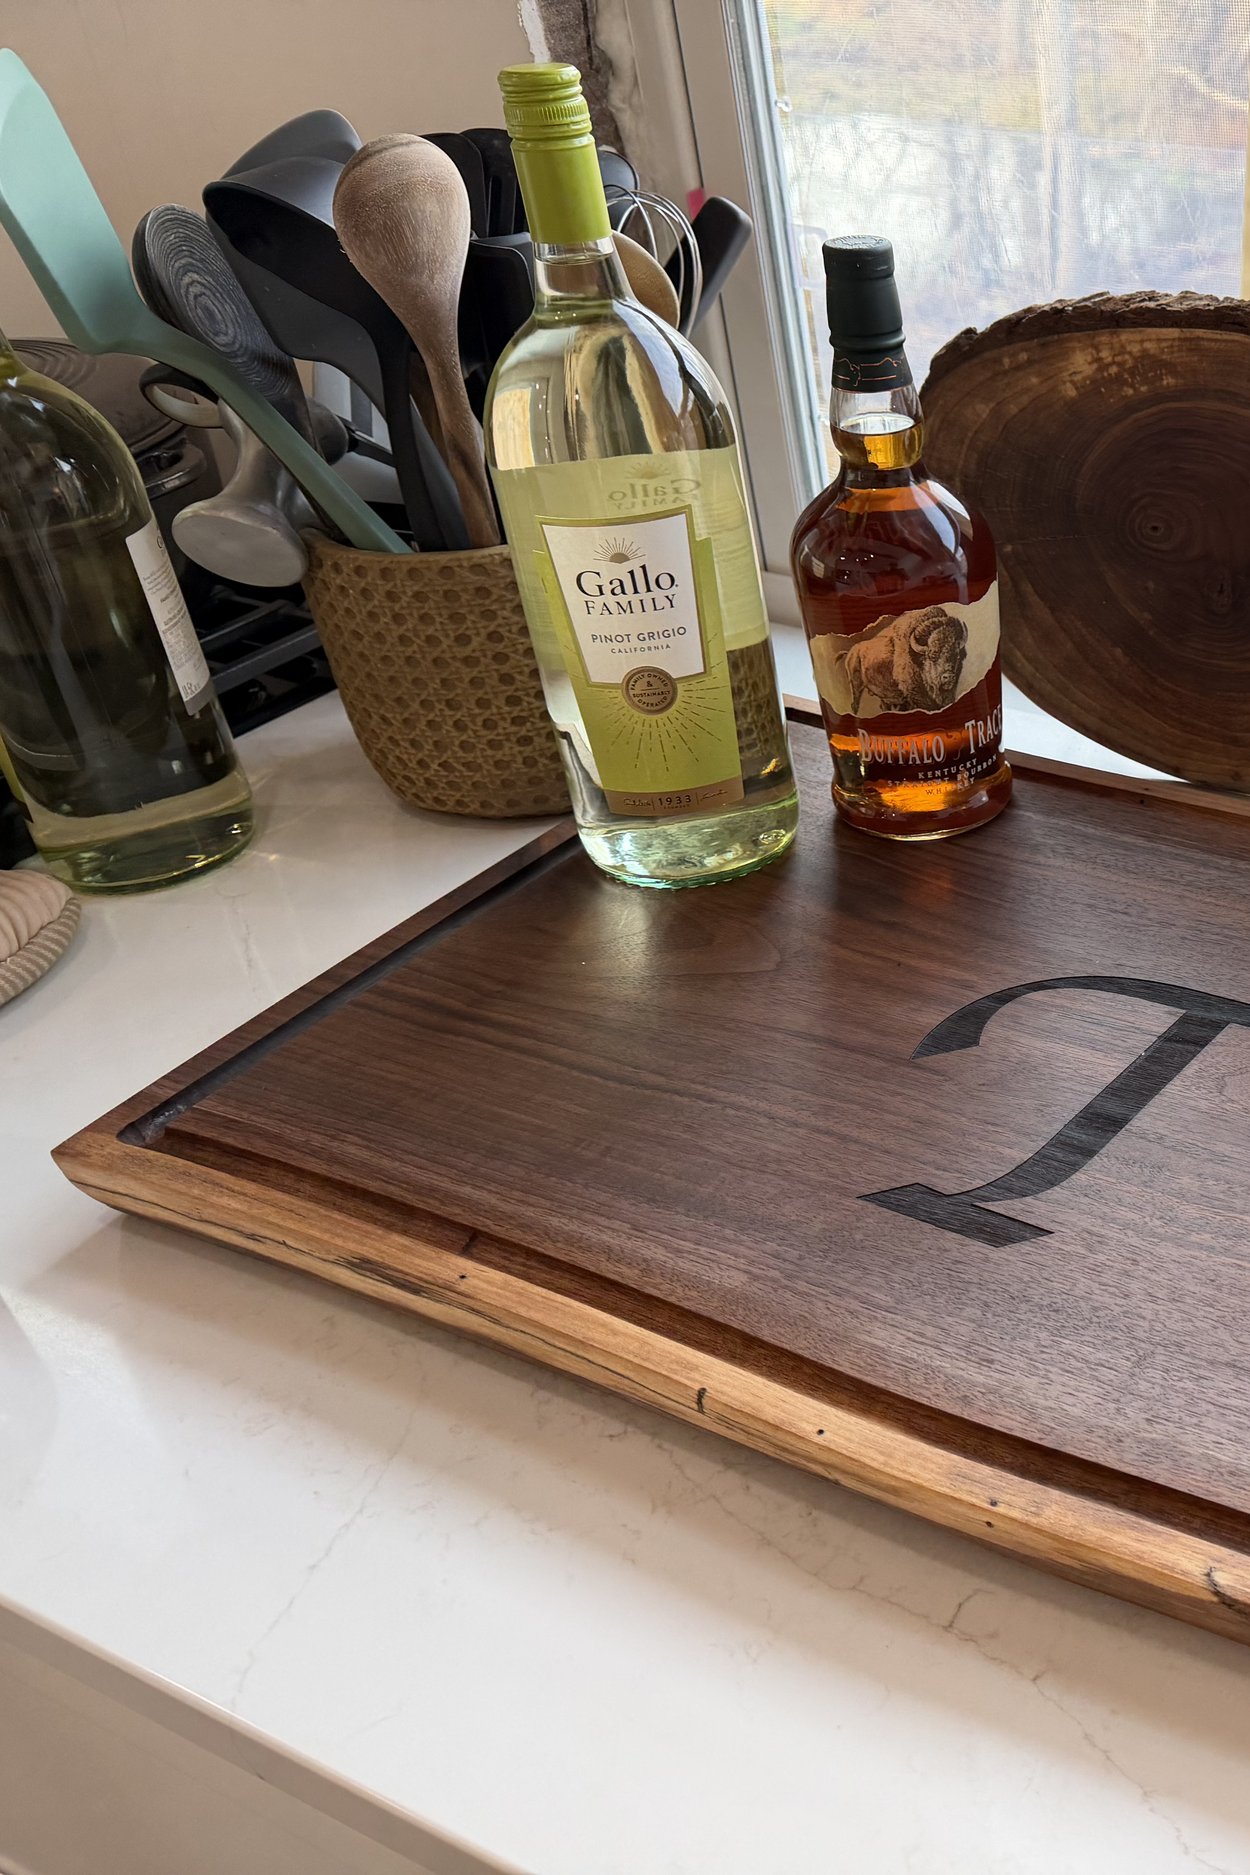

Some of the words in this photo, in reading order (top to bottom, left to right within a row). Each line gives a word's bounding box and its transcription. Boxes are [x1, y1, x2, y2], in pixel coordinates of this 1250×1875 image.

[576, 563, 676, 597] Gallo
[584, 594, 676, 615] FAMILY
[591, 633, 632, 643] PINOT
[637, 626, 687, 642] GRIGIO
[611, 643, 671, 654] CALIFORNIA
[918, 758, 977, 779] KENTUCKY
[658, 795, 691, 806] 1933
